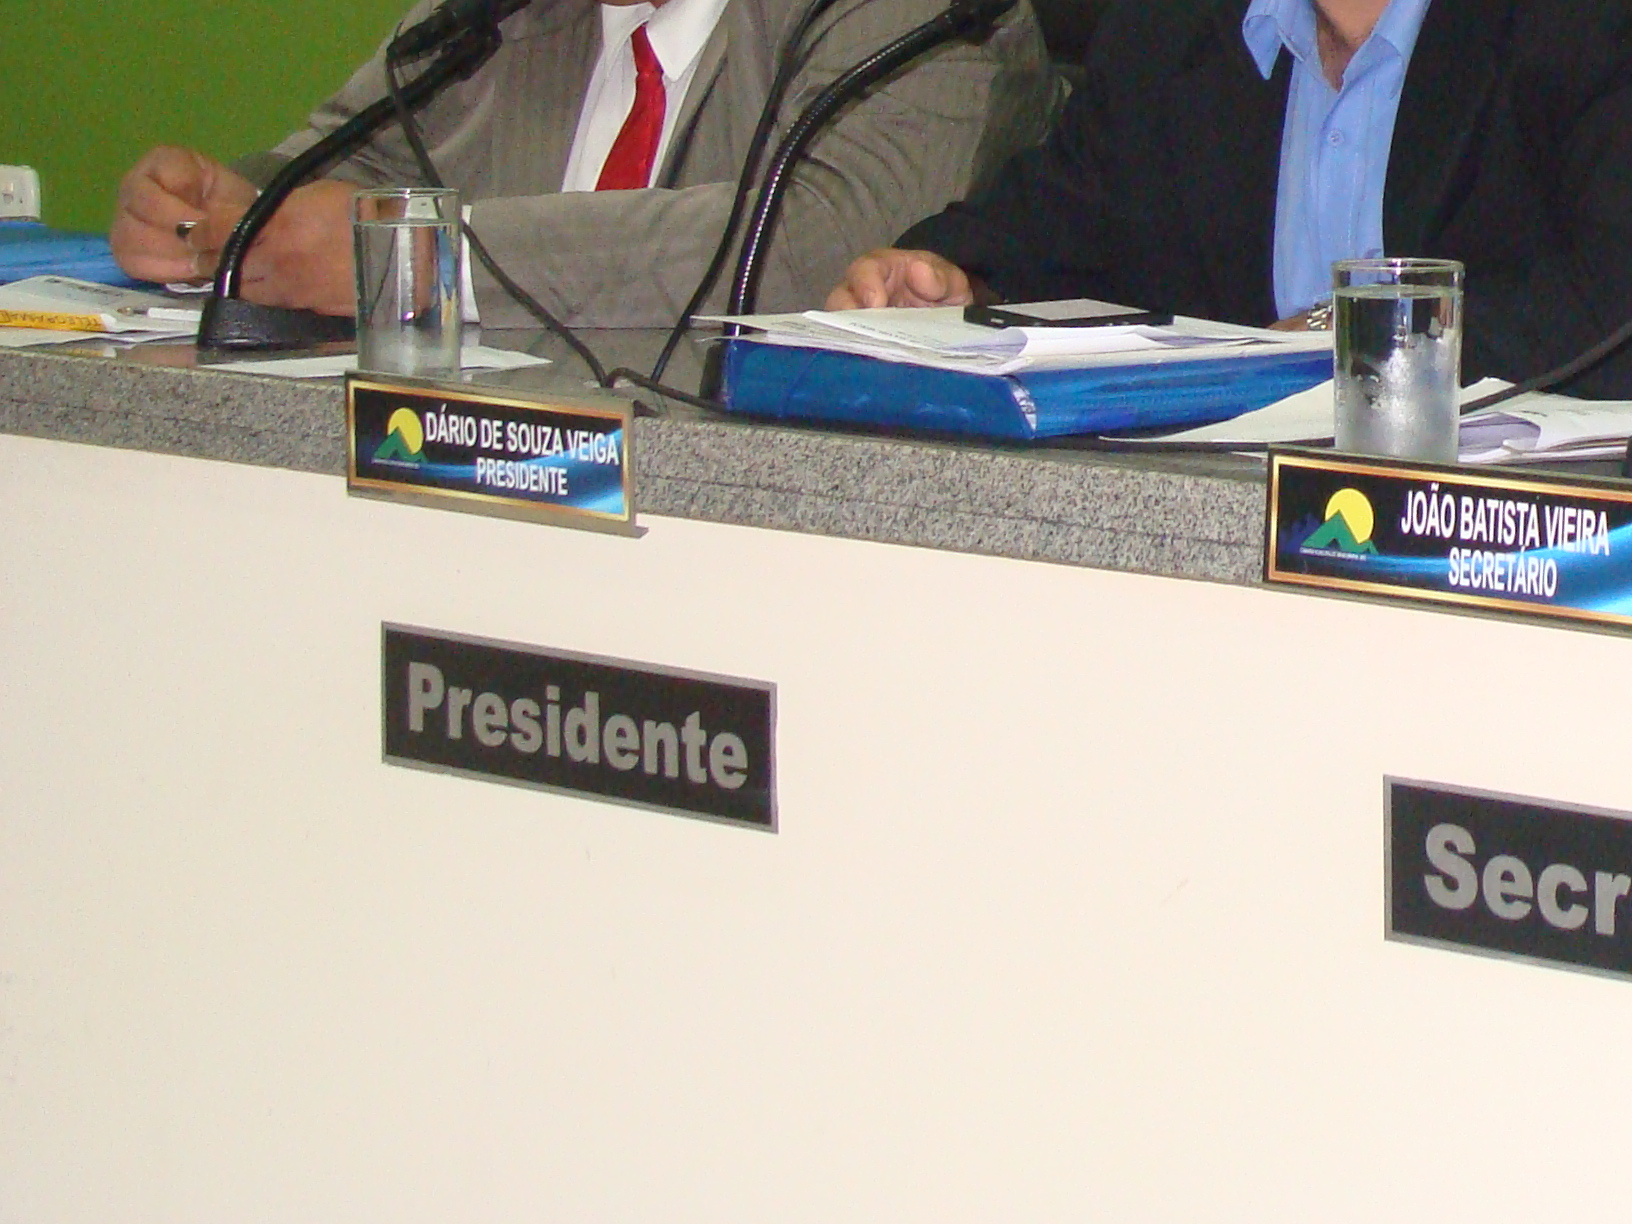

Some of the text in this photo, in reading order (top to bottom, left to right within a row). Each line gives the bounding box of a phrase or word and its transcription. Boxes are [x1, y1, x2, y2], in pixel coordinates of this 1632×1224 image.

[425, 403, 620, 466] DÁRIO DE SOUZA VEIGA
[475, 457, 568, 496] PRESIDENTE
[1400, 482, 1610, 556] JOÃO BATISTA VIEIRA
[1448, 545, 1558, 598] SECRETÁRIO
[407, 660, 749, 790] Presidente
